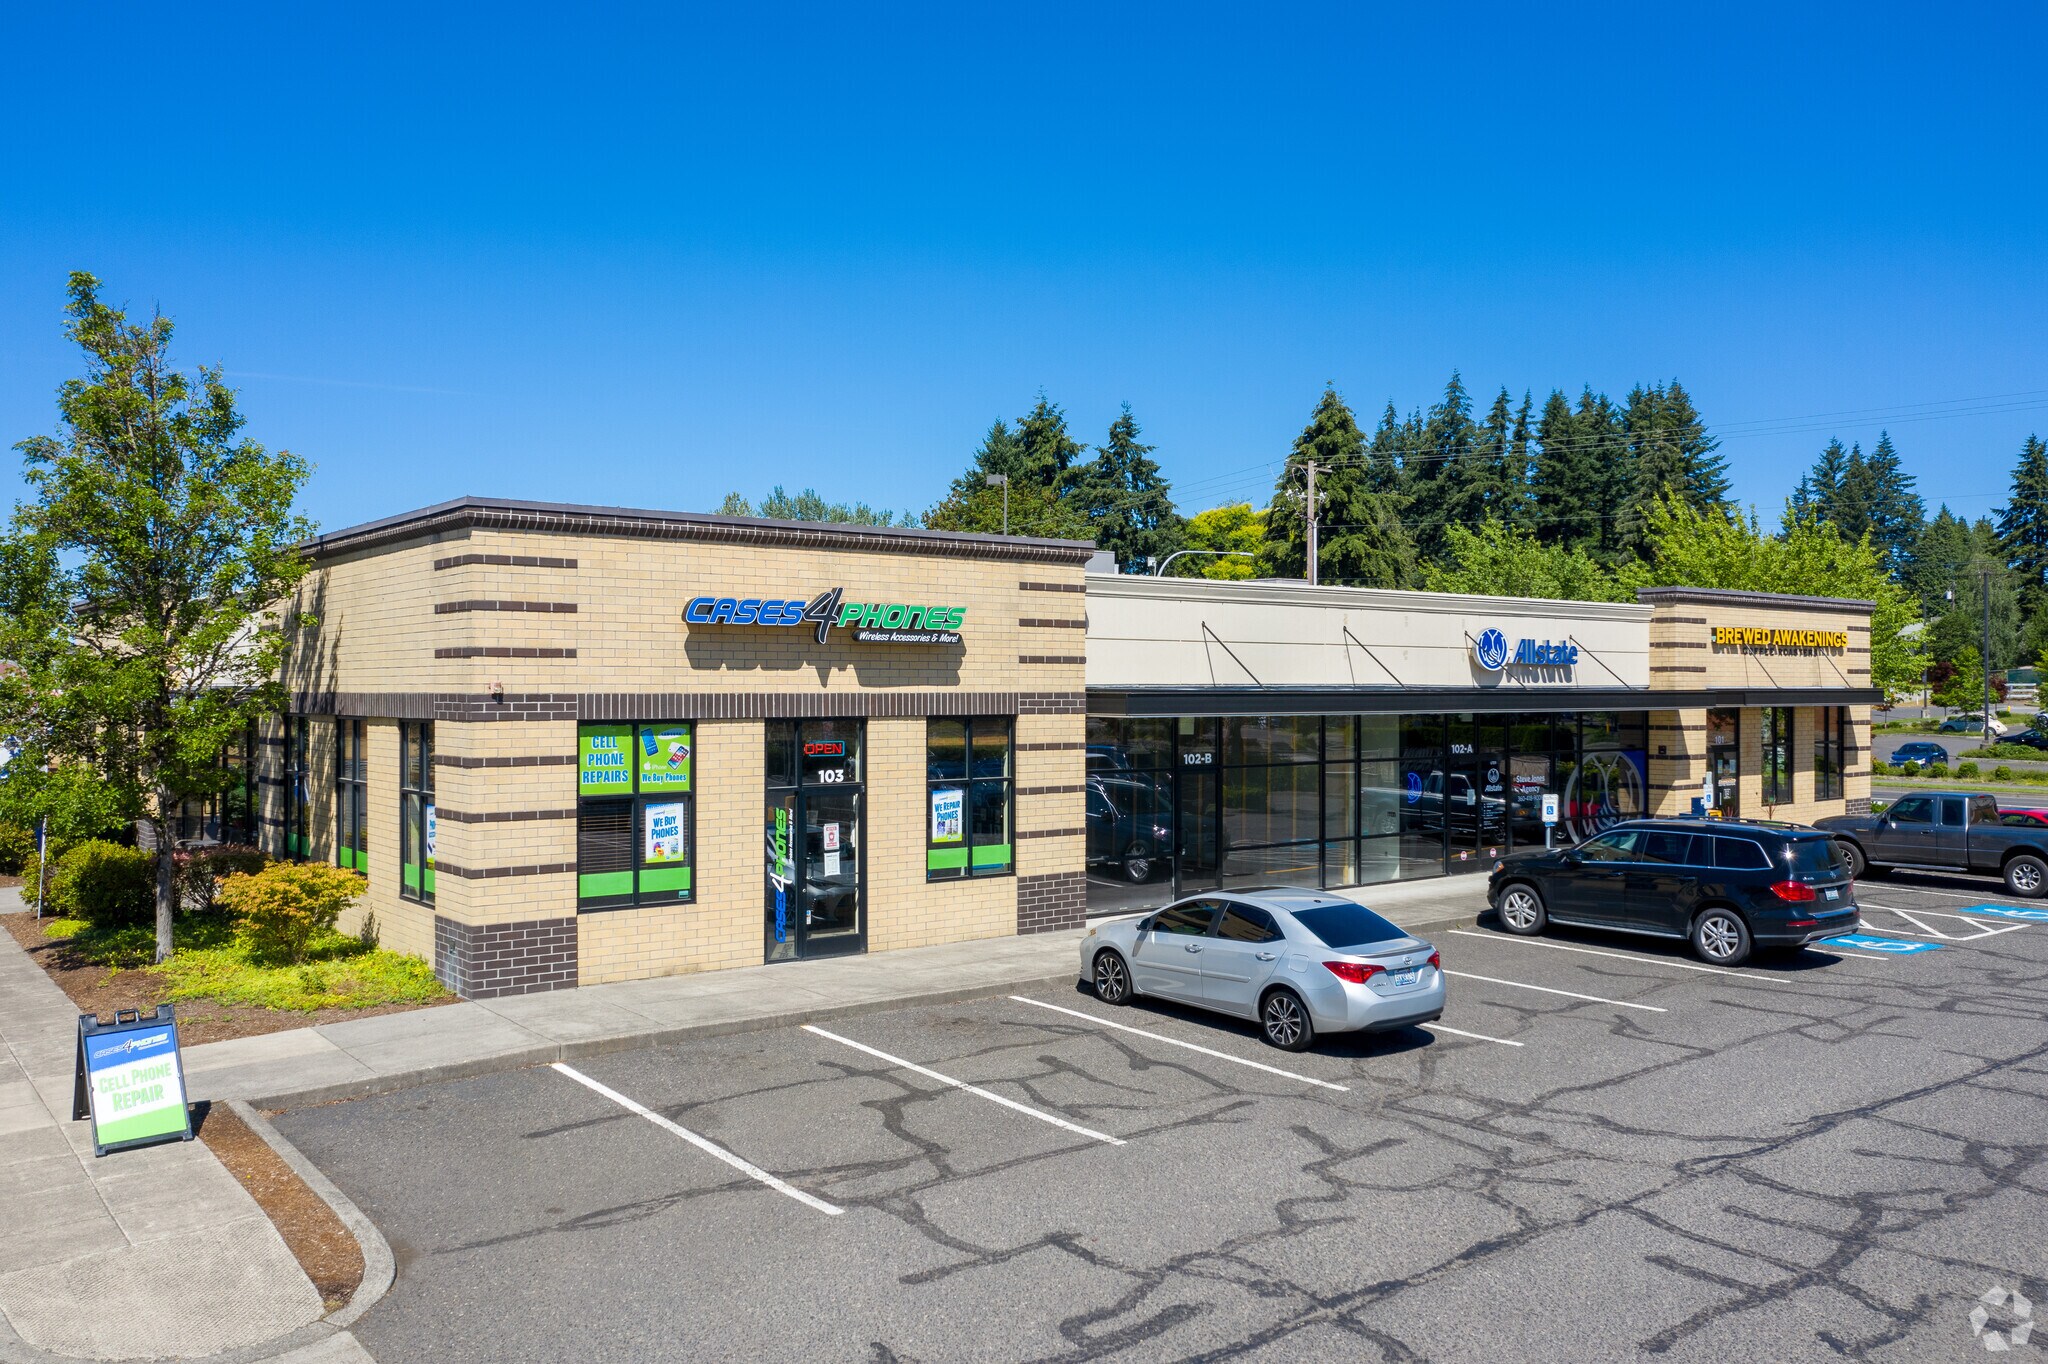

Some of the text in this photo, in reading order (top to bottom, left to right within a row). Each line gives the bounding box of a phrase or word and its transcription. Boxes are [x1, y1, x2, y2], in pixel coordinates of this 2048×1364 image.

[859, 631, 959, 643] Wireless Accessories & More!
[1716, 627, 1849, 648] BREWED AWAKENINGS
[1512, 638, 1578, 665] Allstate
[1742, 647, 1776, 657] COFFEE
[592, 736, 618, 749] CELL
[1715, 735, 1725, 744] 101
[804, 743, 842, 755] OPEN
[1451, 744, 1473, 754] 102-A
[588, 753, 624, 766] PHONE
[1183, 753, 1212, 765] 102-B
[582, 770, 629, 784] REPAIRS
[642, 772, 687, 784] We Buy Phones
[818, 769, 845, 783] 103
[1516, 775, 1545, 783] Steve Jones
[1522, 785, 1540, 794] Agency
[935, 800, 961, 813] WE REPAIR
[653, 815, 676, 828] WE BUY
[937, 810, 959, 822] PHONES
[651, 826, 679, 840] PHONES
[99, 1062, 172, 1094] CELL PHONE
[112, 1084, 164, 1112] REPAIR
